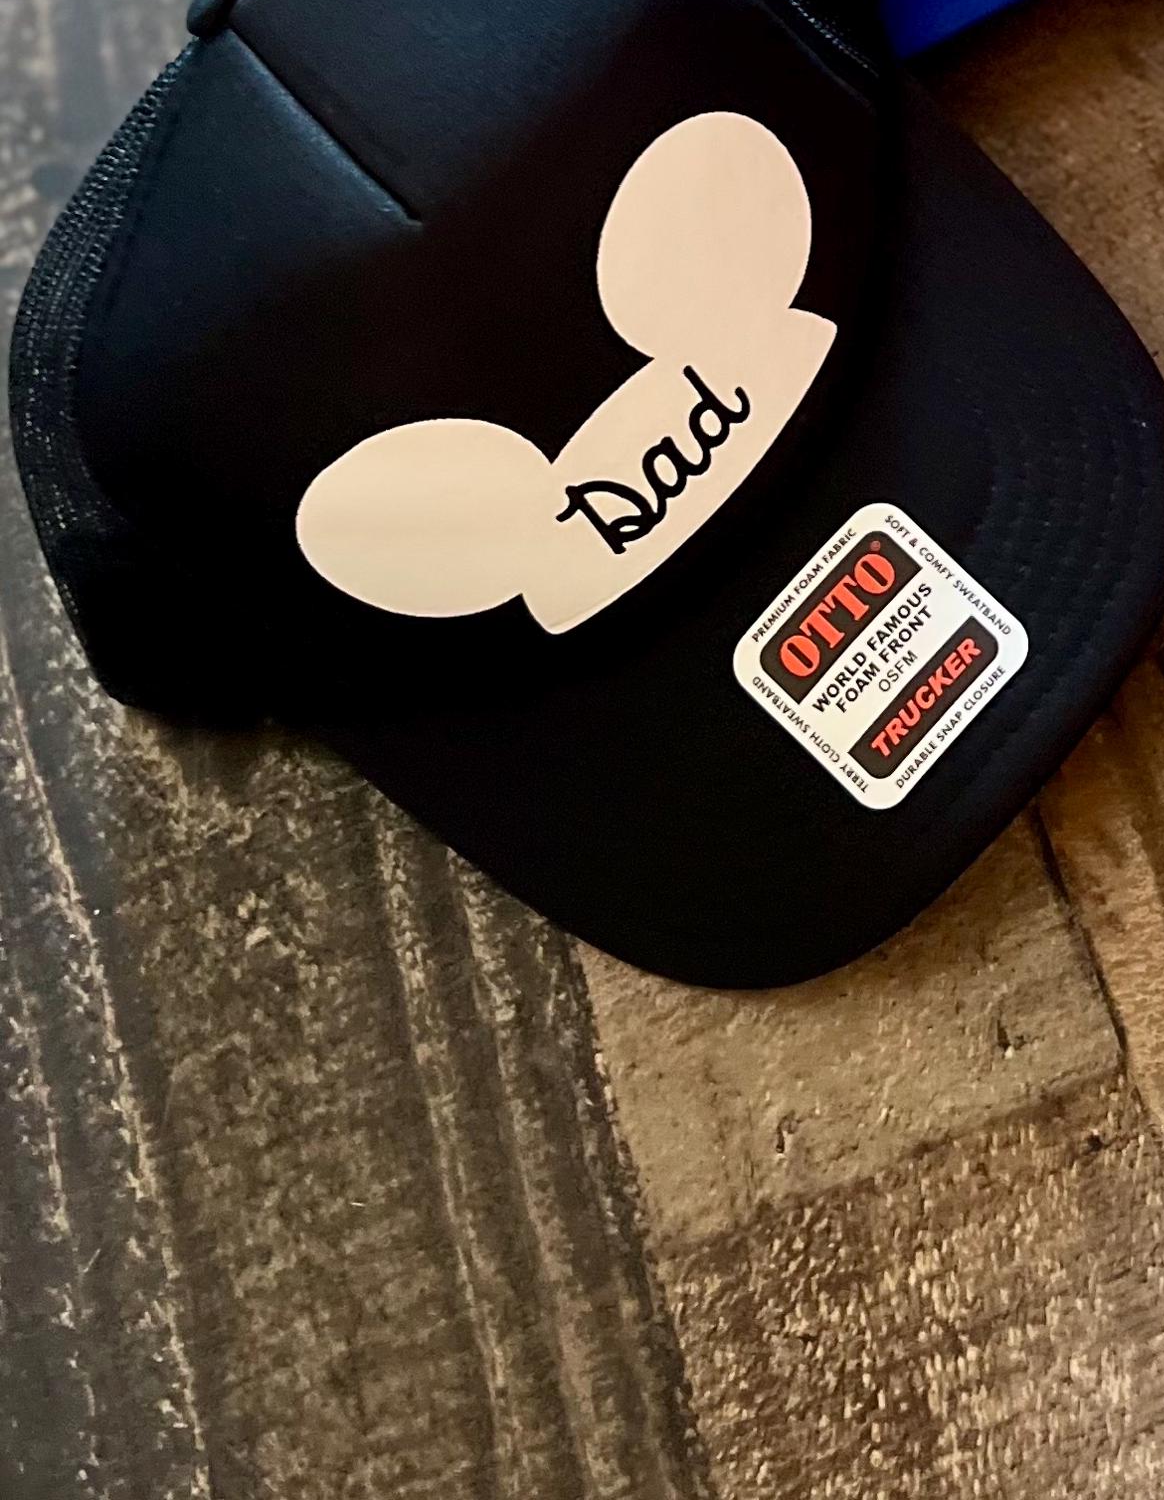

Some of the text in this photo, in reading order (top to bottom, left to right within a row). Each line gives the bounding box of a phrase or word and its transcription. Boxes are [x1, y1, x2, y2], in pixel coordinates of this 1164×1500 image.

[556, 365, 750, 554] Dad
[751, 528, 857, 643] PREMIUM FOAM FABRIC
[780, 553, 895, 677] OTTO
[884, 515, 1012, 636] SOFT & COMFY SWEATBAND
[752, 675, 810, 733] SWEATBAND
[811, 583, 932, 714] WORLD FAMOUS
[836, 604, 933, 714] FOAM FRONT
[871, 637, 982, 758] TRUCKER
[878, 650, 918, 693] OSFM
[809, 731, 841, 764] CLOTH
[896, 666, 1006, 789] DURABLE SNAP CLOSURE
